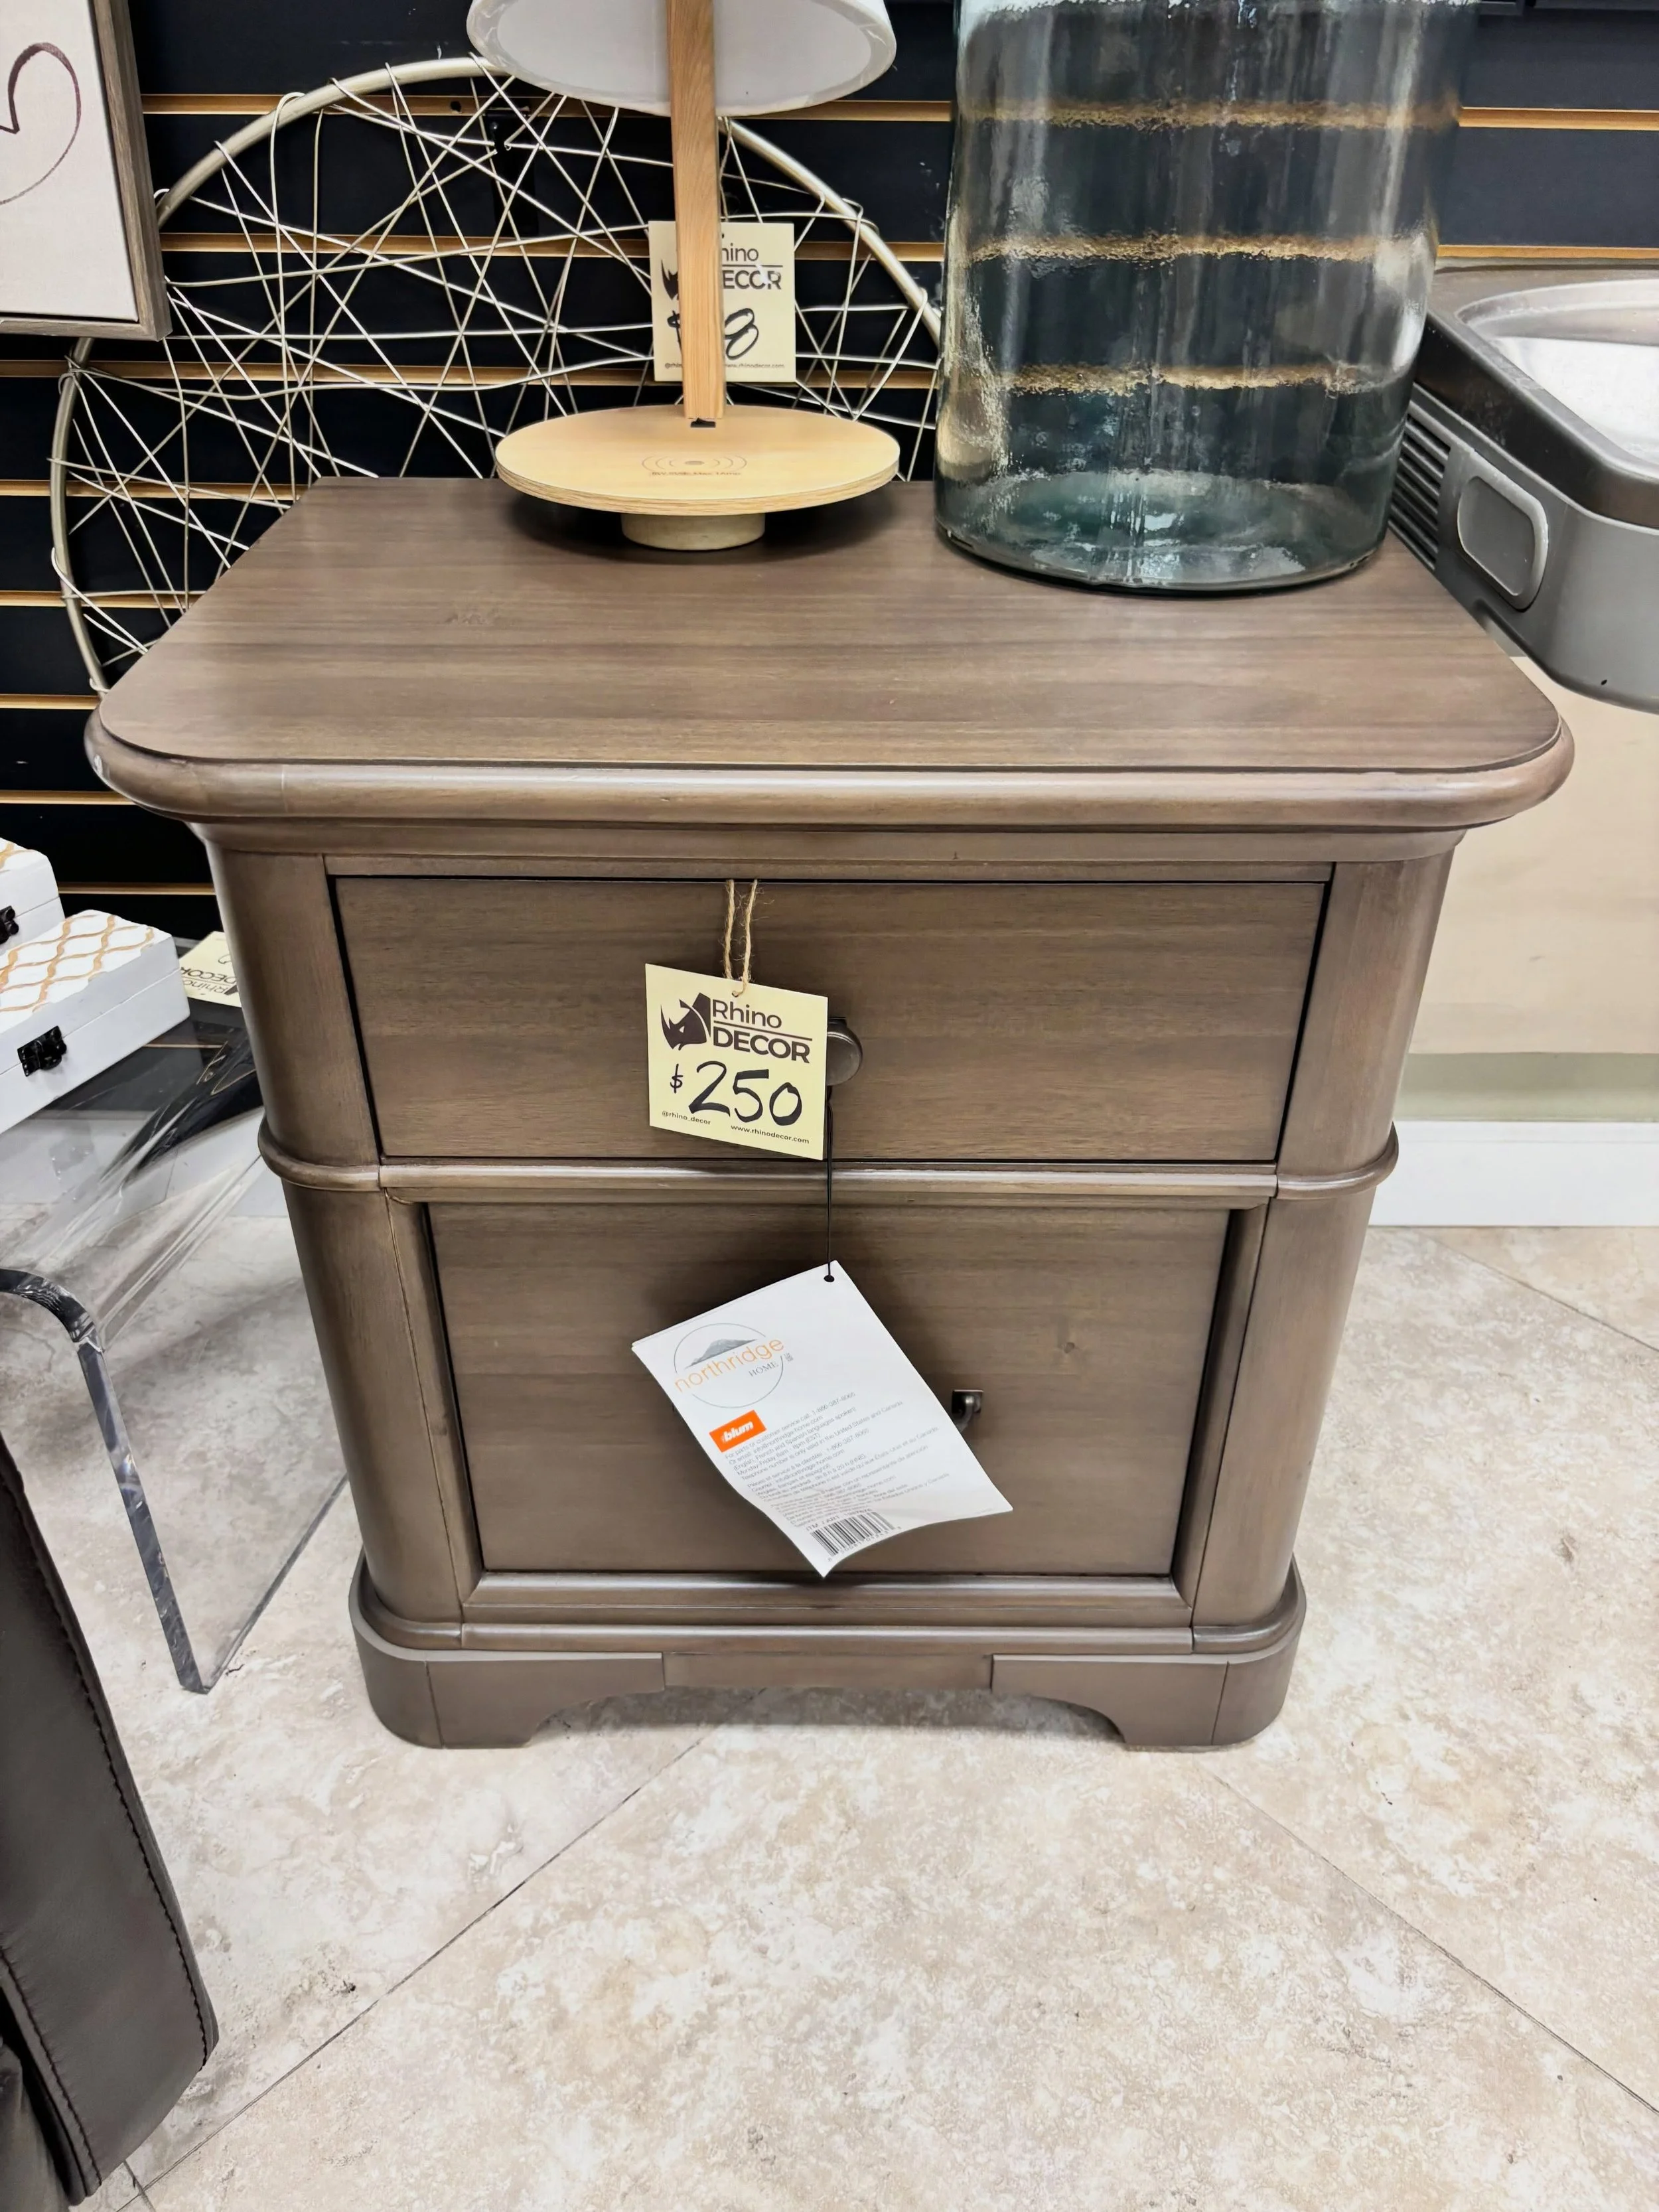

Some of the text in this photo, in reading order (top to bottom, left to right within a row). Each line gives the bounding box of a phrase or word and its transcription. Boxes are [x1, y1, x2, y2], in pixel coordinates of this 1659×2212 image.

[721, 243, 758, 261] hino
[723, 270, 782, 289] ECOR
[713, 999, 782, 1029] Rhino
[713, 1026, 810, 1063] DECOR
[662, 1110, 711, 1126] @rhino_decor
[731, 1125, 810, 1144] www.rhinodecor.com
[674, 1339, 784, 1392] northridge
[749, 1361, 778, 1377] HOME
[722, 1421, 754, 1443] blum
[781, 1419, 800, 1430] service
[785, 1431, 807, 1445] Spanish
[807, 1418, 835, 1434] languages
[834, 1424, 853, 1436] United
[806, 1432, 820, 1442] (EST)
